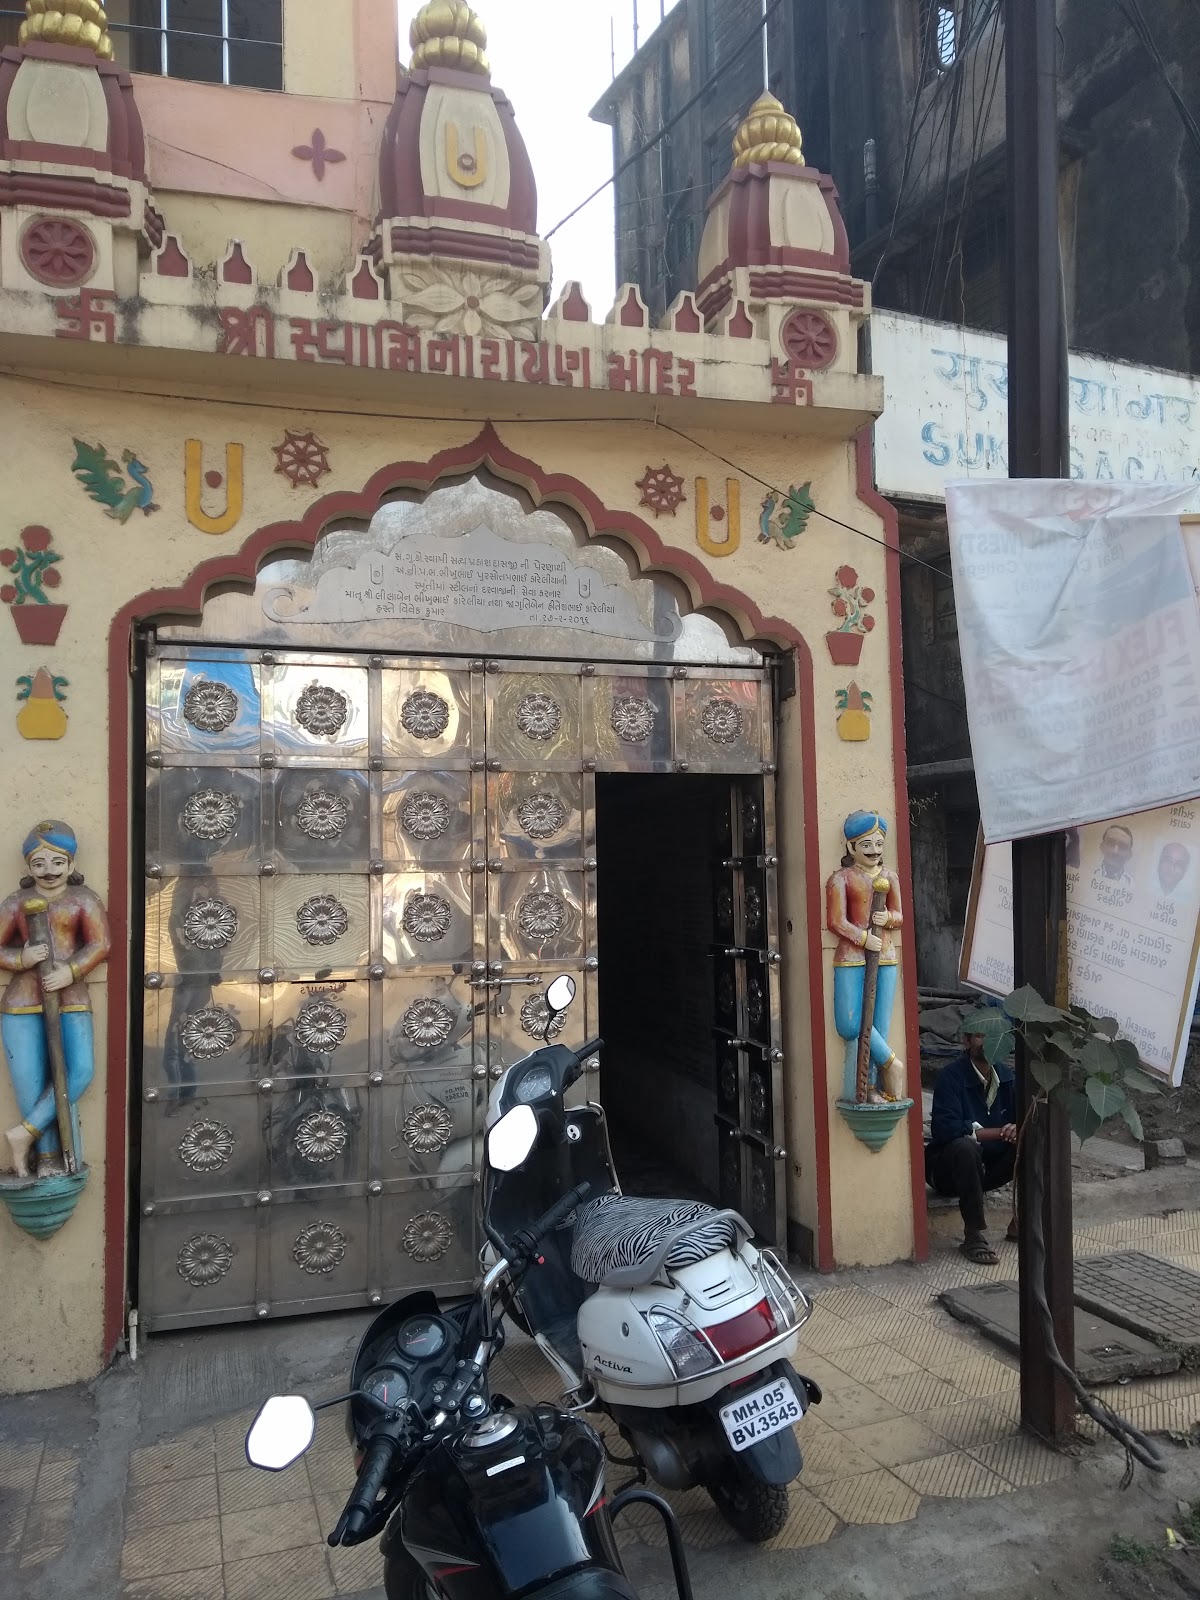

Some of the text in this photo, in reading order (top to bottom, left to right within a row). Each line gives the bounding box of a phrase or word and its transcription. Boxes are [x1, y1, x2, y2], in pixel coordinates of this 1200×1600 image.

[217, 304, 275, 358] શ્રી
[608, 347, 698, 399] મંદિર
[921, 421, 1007, 470] SUK
[594, 1354, 633, 1374] Activa
[731, 1386, 784, 1424] MH.05
[731, 1401, 799, 1446] BV.3545
